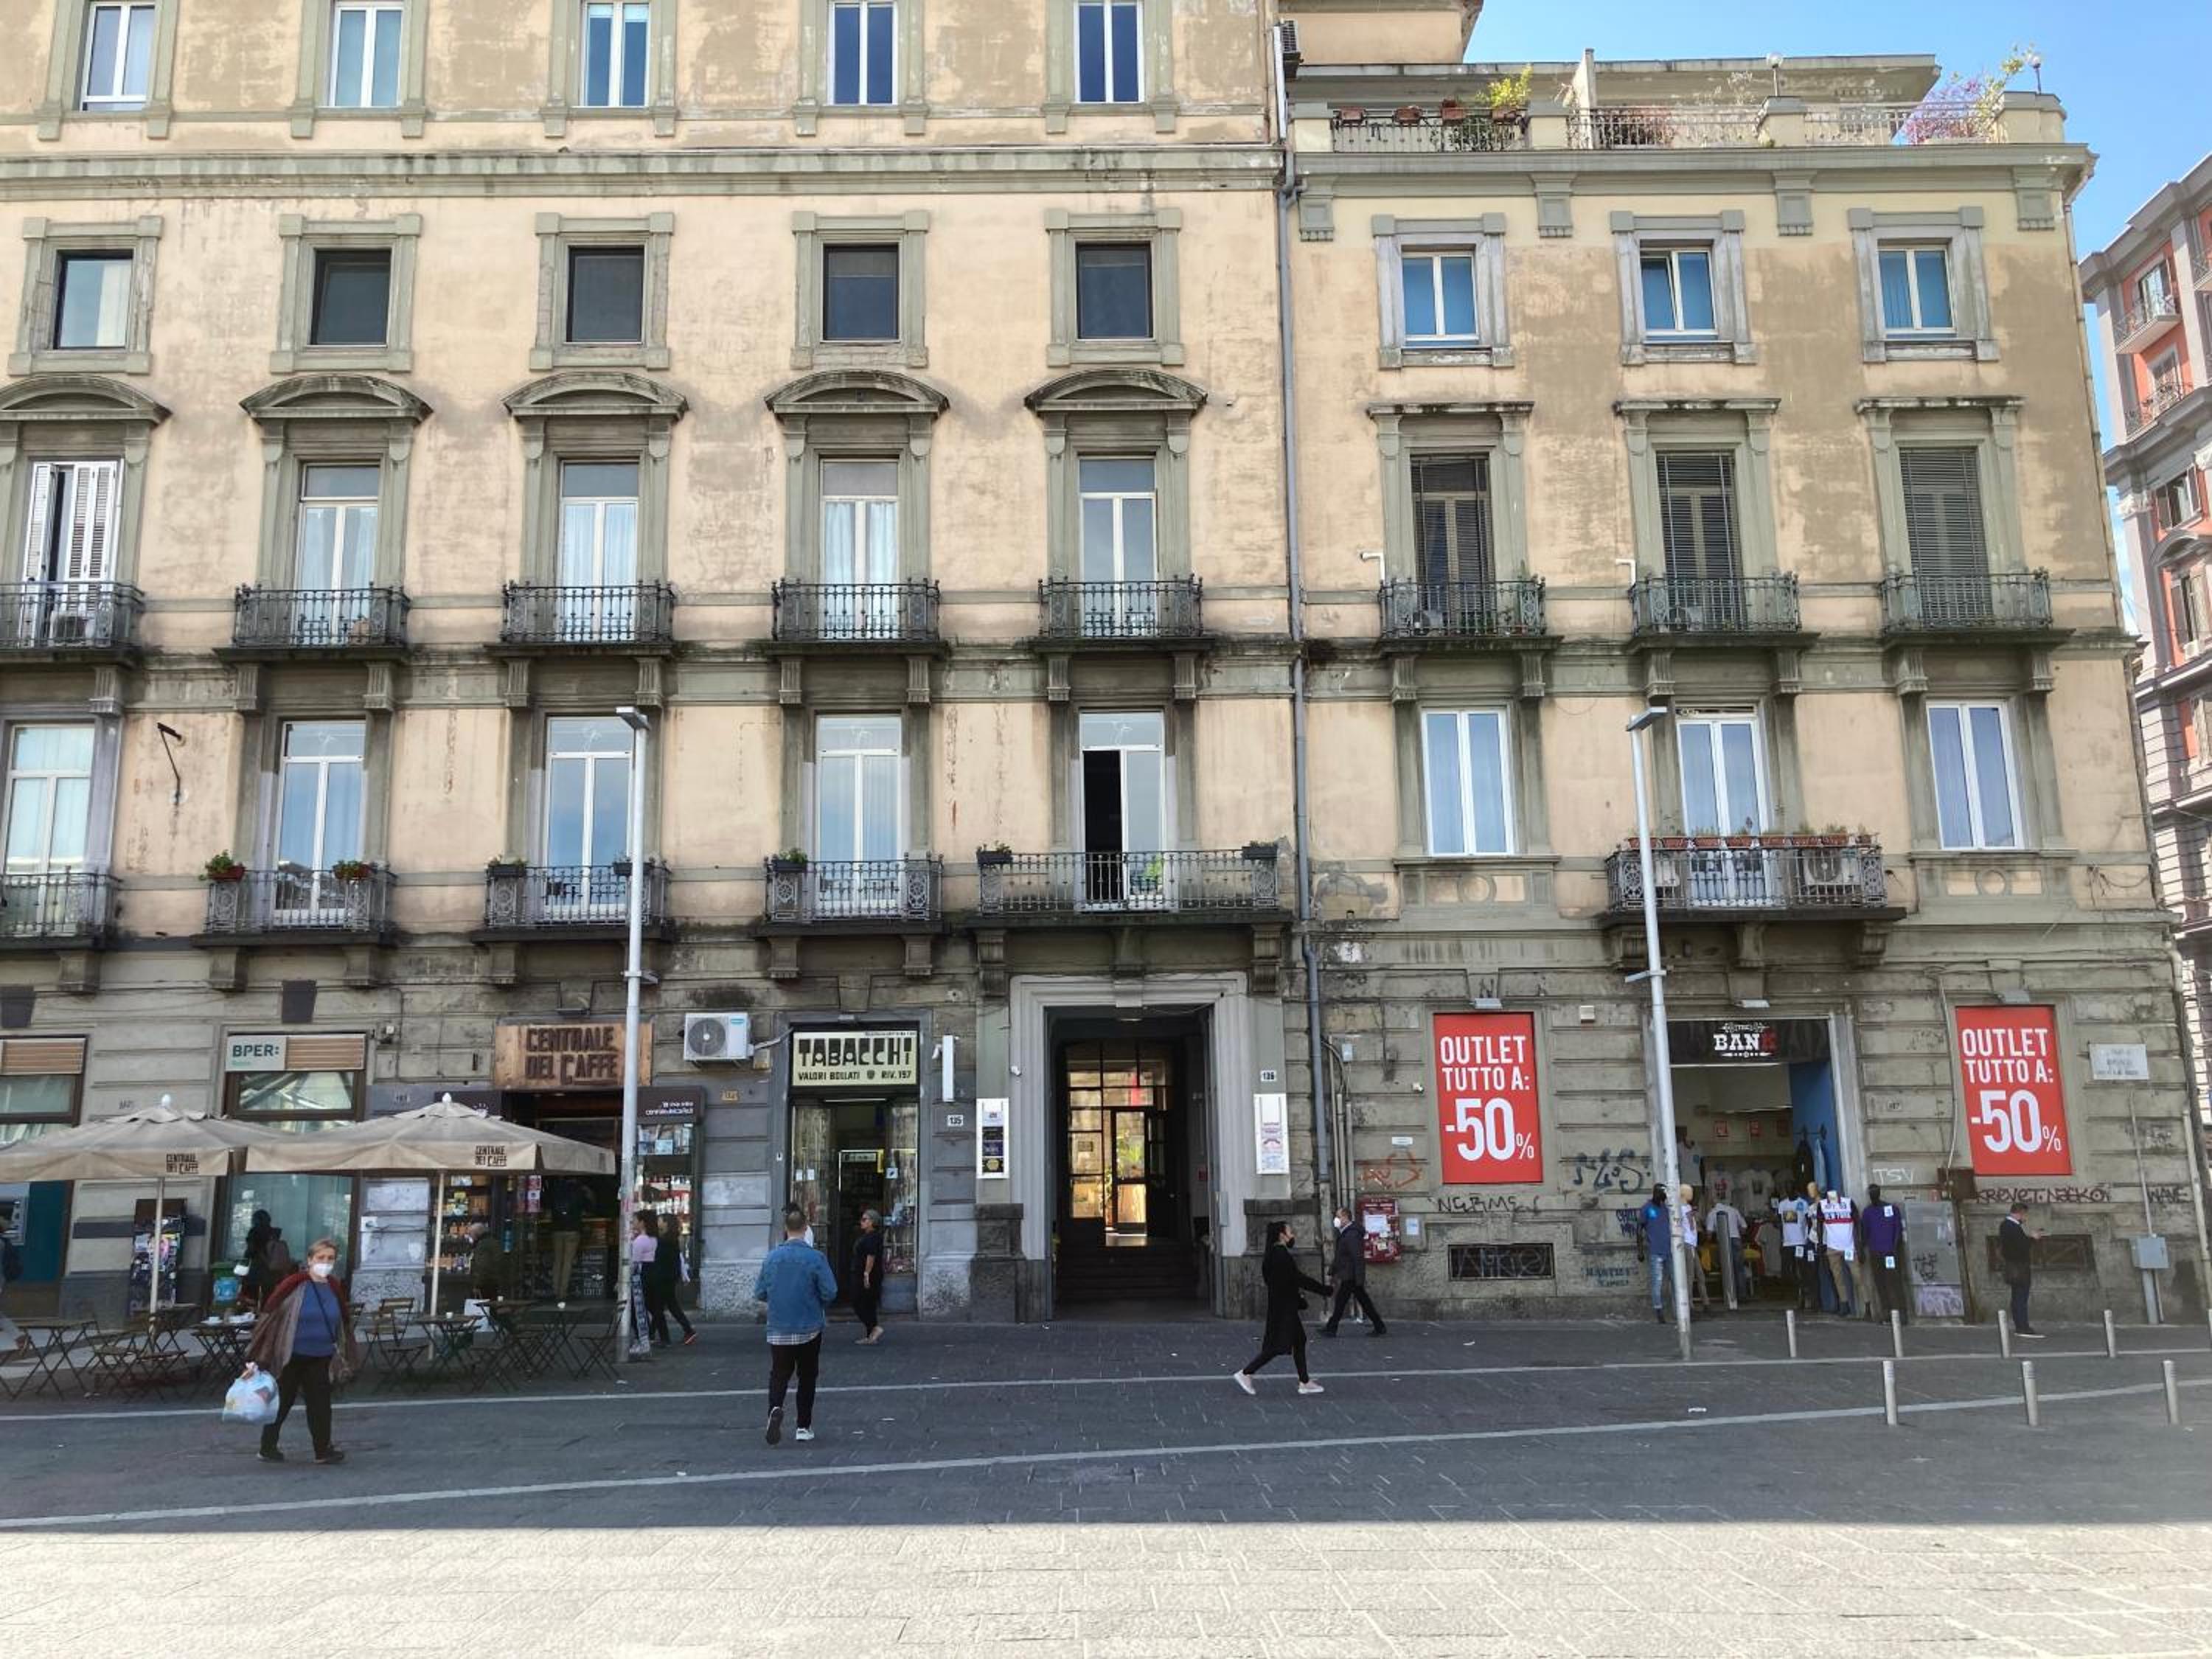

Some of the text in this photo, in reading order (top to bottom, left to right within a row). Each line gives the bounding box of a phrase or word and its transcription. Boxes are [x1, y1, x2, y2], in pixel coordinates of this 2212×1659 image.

[526, 1027, 617, 1052] CENTRALE
[798, 1038, 912, 1066] TABACCHI
[1440, 1035, 1526, 1065] OUTLET
[1961, 1028, 2048, 1057] OUTLET
[526, 1054, 555, 1079] DEL
[798, 1071, 827, 1081] VALORI
[830, 1070, 860, 1080] BOLLATI
[1441, 1065, 1530, 1091] TUTTO A:
[1964, 1059, 2054, 1084] TUTTO A:
[1445, 1097, 1534, 1161] -50%
[1971, 1089, 2062, 1153] -50%
